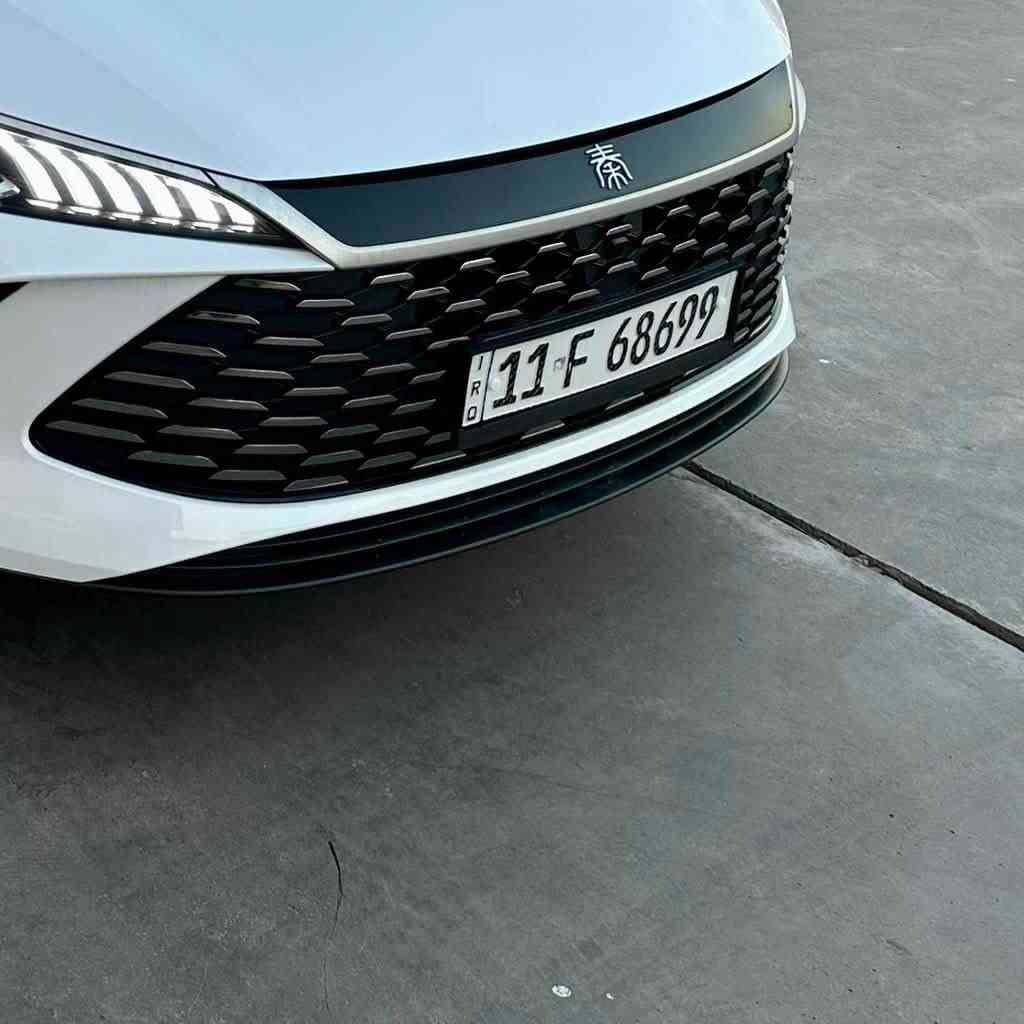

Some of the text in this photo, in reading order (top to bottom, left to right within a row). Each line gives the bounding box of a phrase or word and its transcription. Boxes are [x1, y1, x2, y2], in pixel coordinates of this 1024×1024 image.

[585, 143, 633, 190] 秦
[493, 286, 719, 408] 11 F 68699
